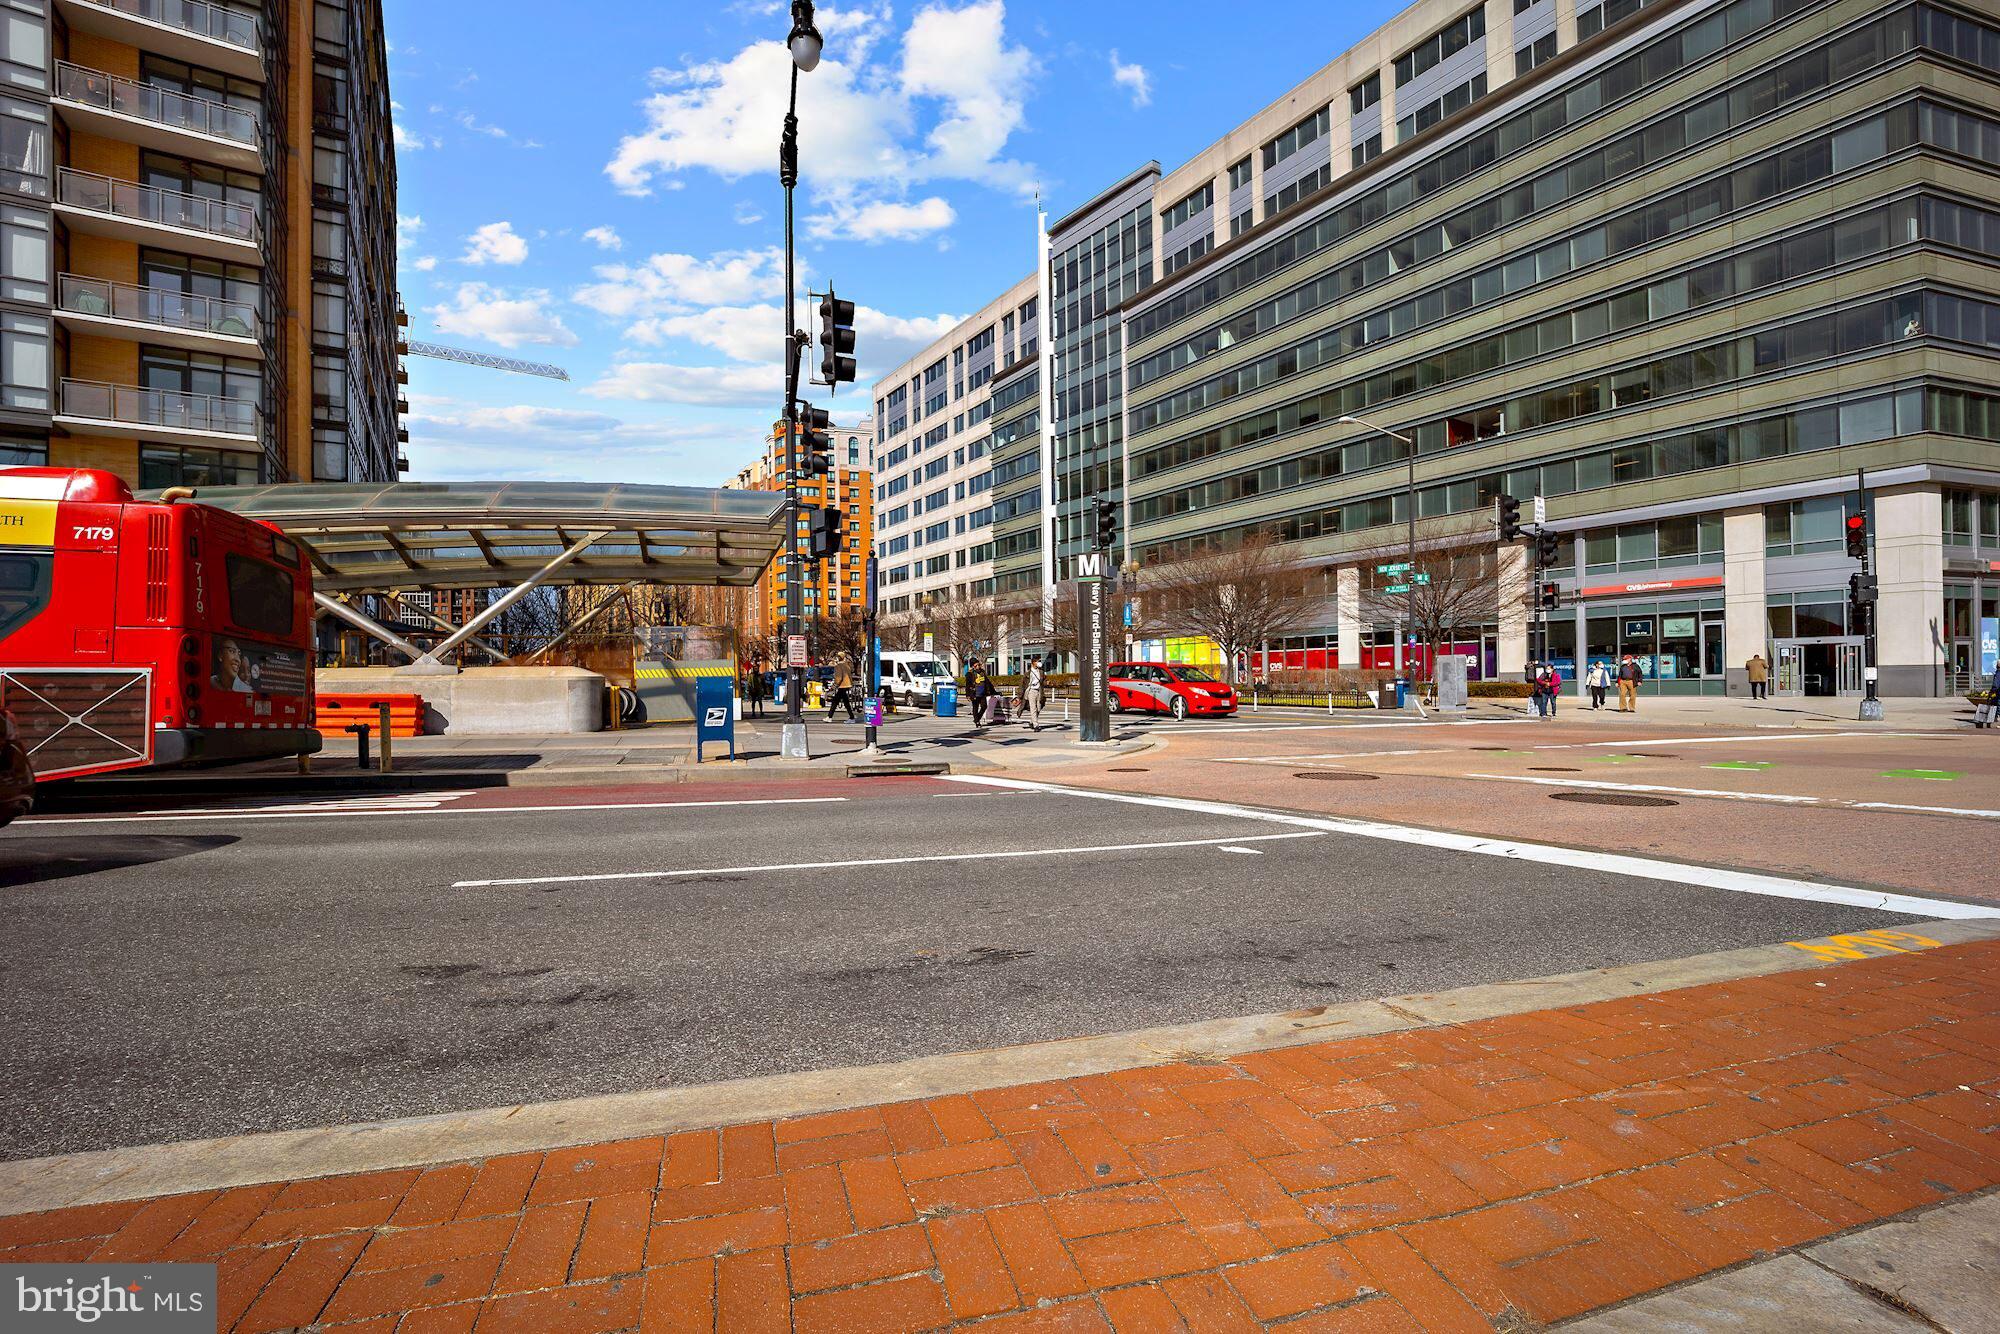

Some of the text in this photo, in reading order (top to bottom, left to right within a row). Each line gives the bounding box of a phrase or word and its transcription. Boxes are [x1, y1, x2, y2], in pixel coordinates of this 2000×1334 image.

[0, 515, 24, 525] TH
[73, 526, 114, 540] 7179
[1079, 553, 1100, 576] M
[195, 562, 204, 613] 7179
[1090, 583, 1102, 704] Navy Yard-Ballpark Station
[1982, 639, 1998, 650] CVS
[1269, 662, 1283, 670] CVS
